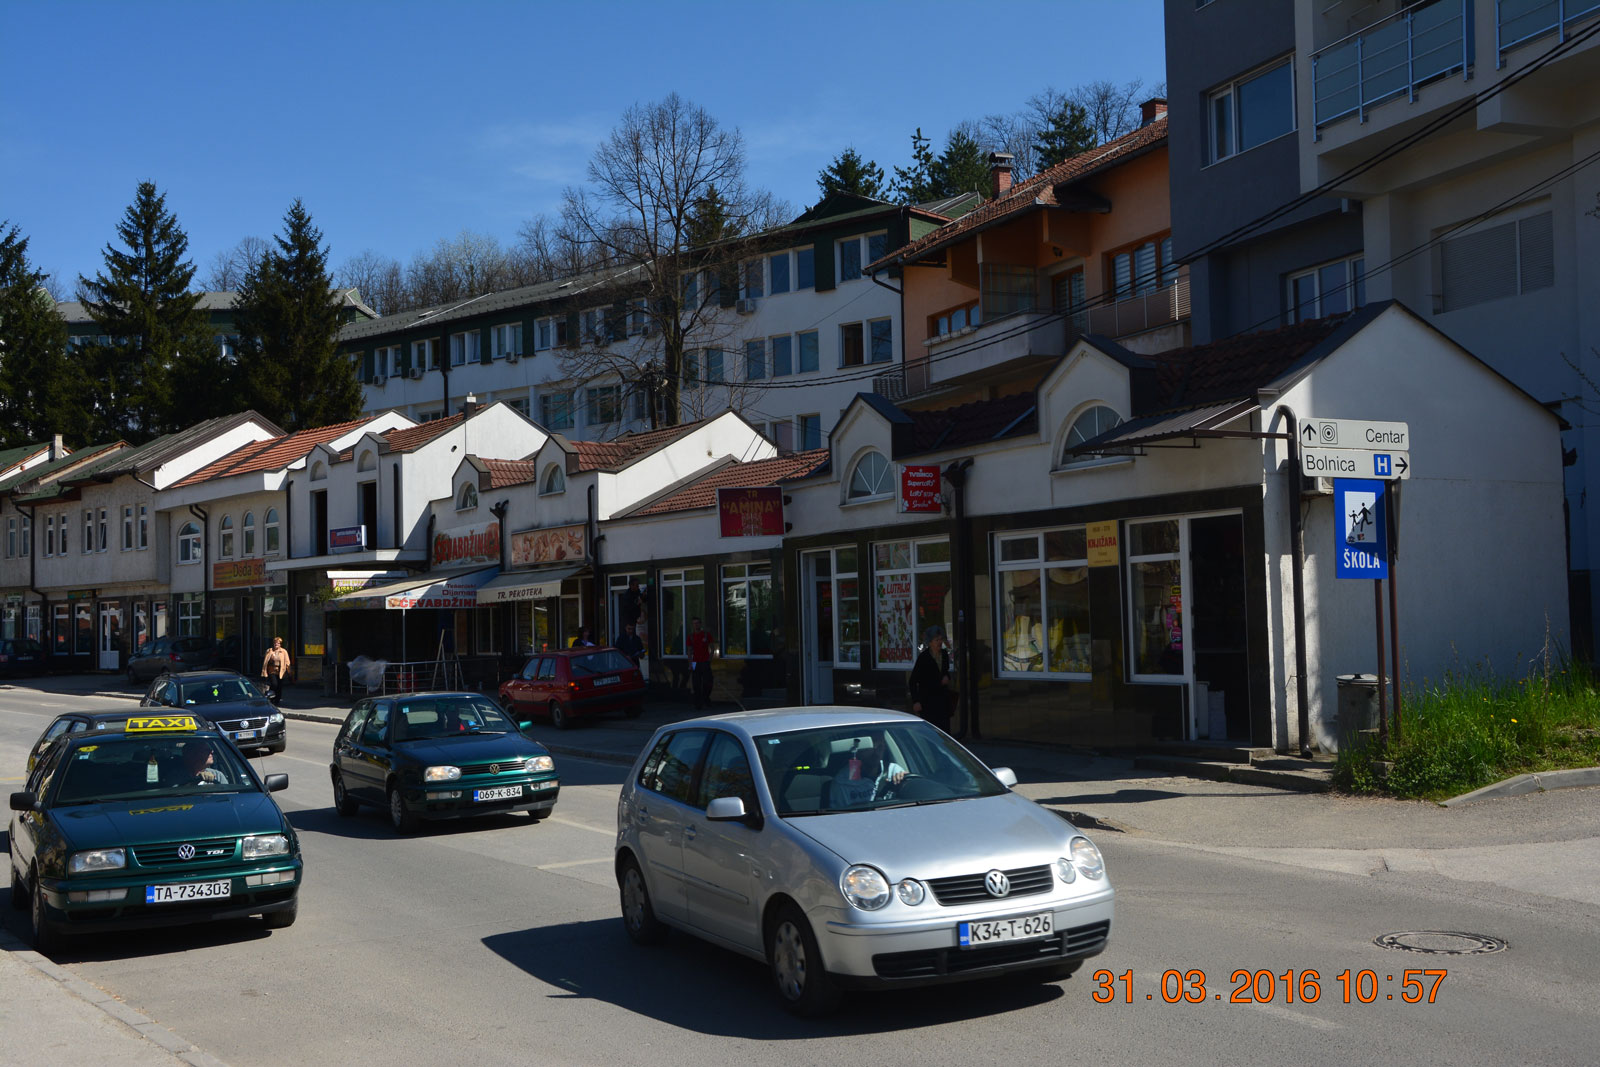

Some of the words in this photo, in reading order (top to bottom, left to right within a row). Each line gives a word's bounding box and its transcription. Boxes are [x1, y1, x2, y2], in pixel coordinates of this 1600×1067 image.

[1365, 428, 1405, 444] Centar
[1306, 454, 1356, 472] Bolnica
[1377, 456, 1388, 473] H
[747, 490, 758, 498] TR
[1088, 535, 1117, 549] KNJIŽARA
[1343, 548, 1381, 569] ŠKOLA
[508, 587, 543, 598] PEKOTEKA
[132, 717, 191, 729] TAXI
[479, 787, 521, 800] 069-K-834
[155, 882, 230, 900] TA-734303
[971, 915, 1051, 942] K34-T-626
